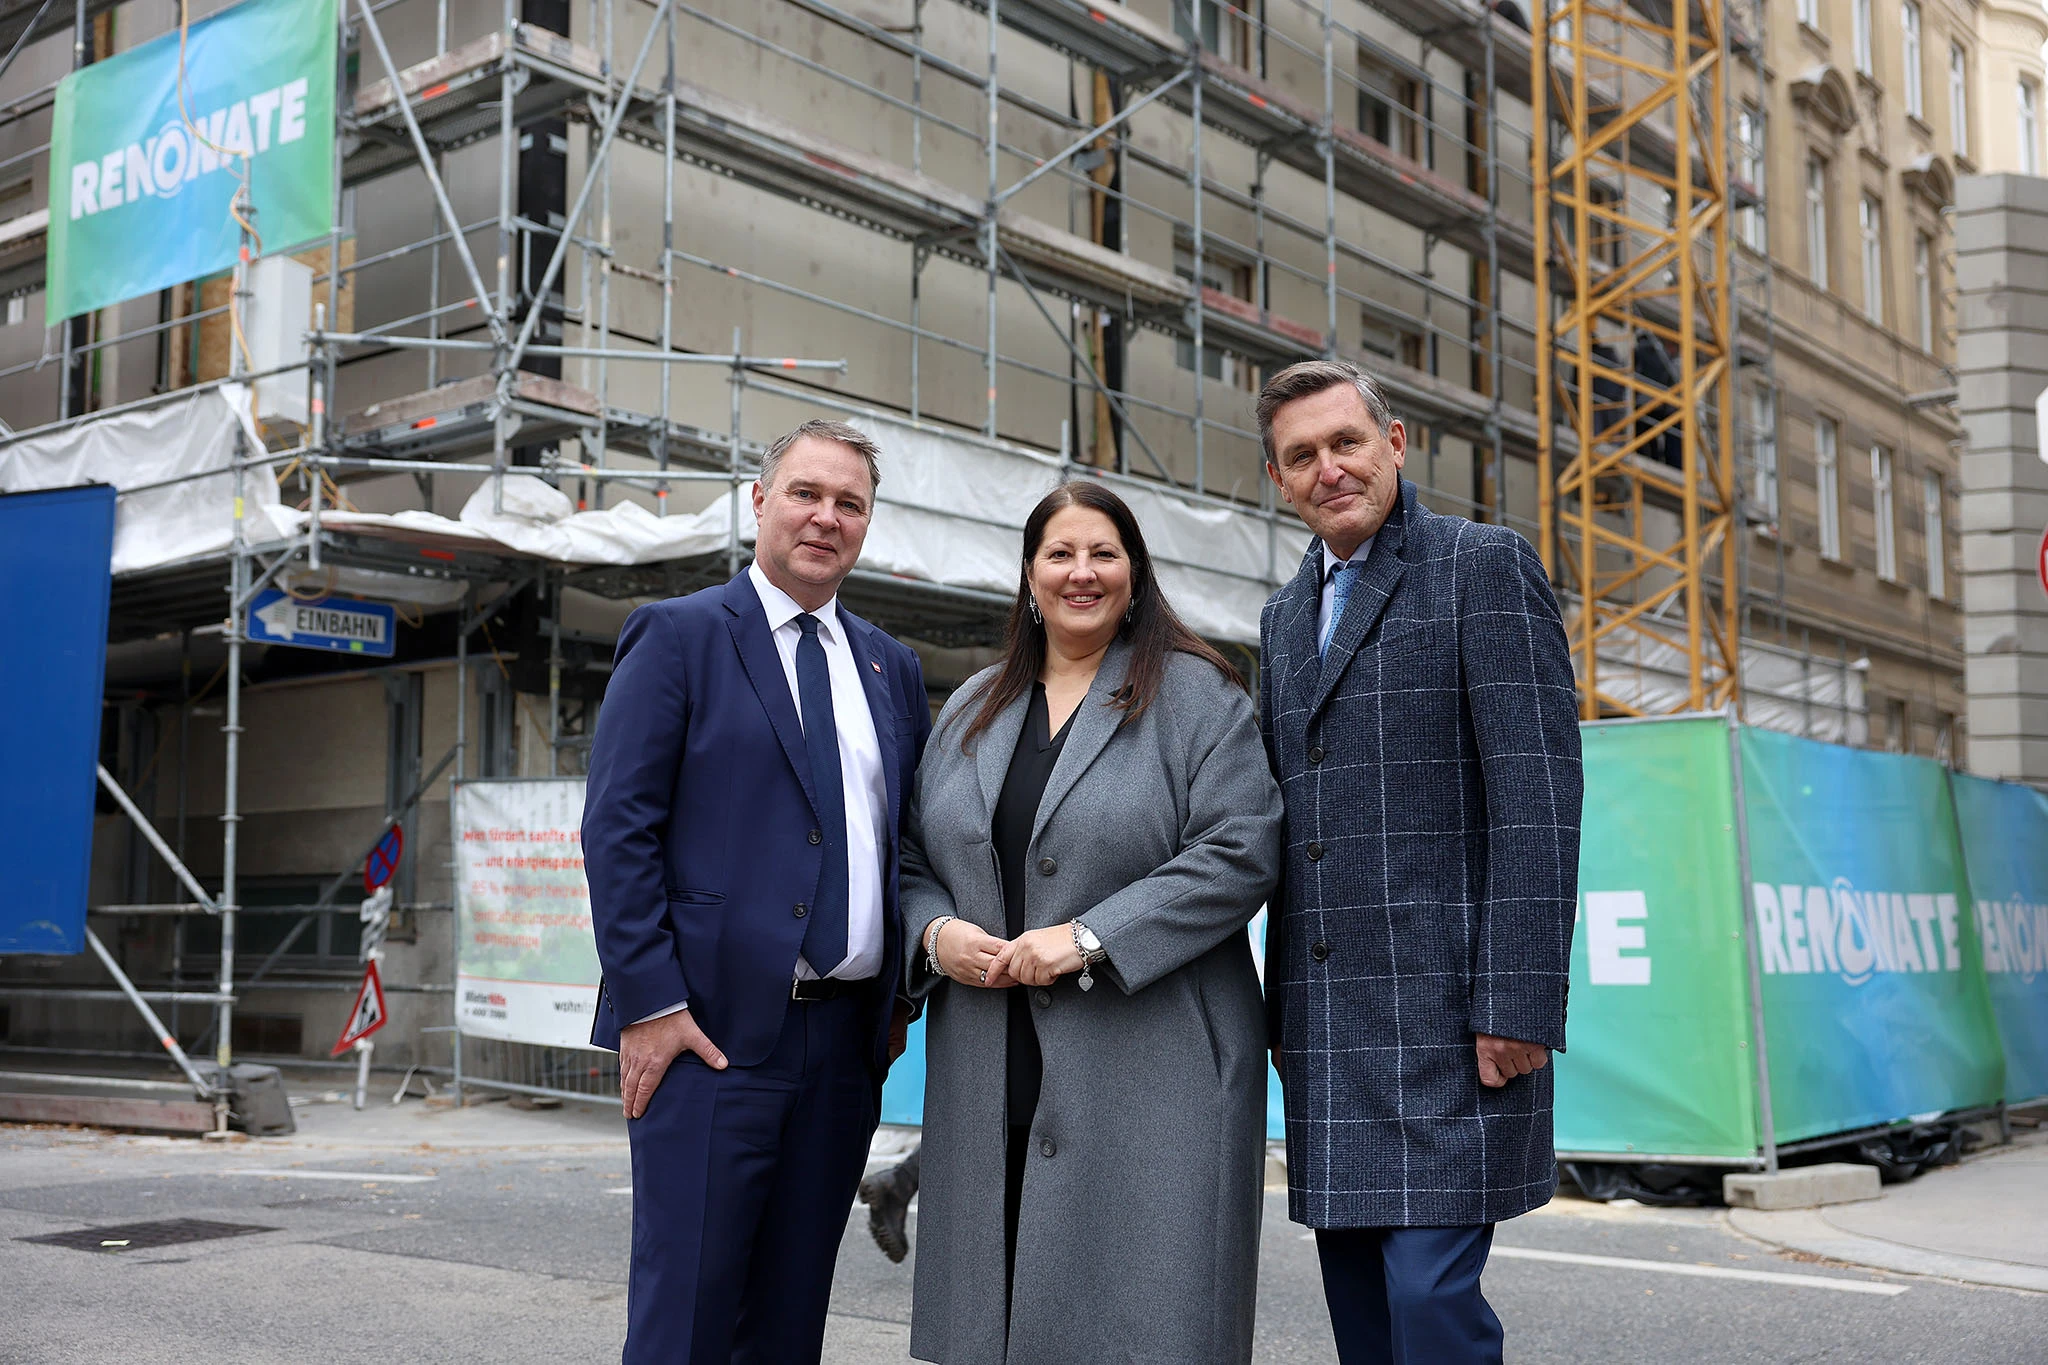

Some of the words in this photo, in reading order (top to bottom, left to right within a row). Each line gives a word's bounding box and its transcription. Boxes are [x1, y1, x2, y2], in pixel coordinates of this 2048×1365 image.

[71, 77, 308, 220] RENOWATE
[296, 607, 378, 638] EINBAHN
[1753, 879, 1961, 982] RENOWATE
